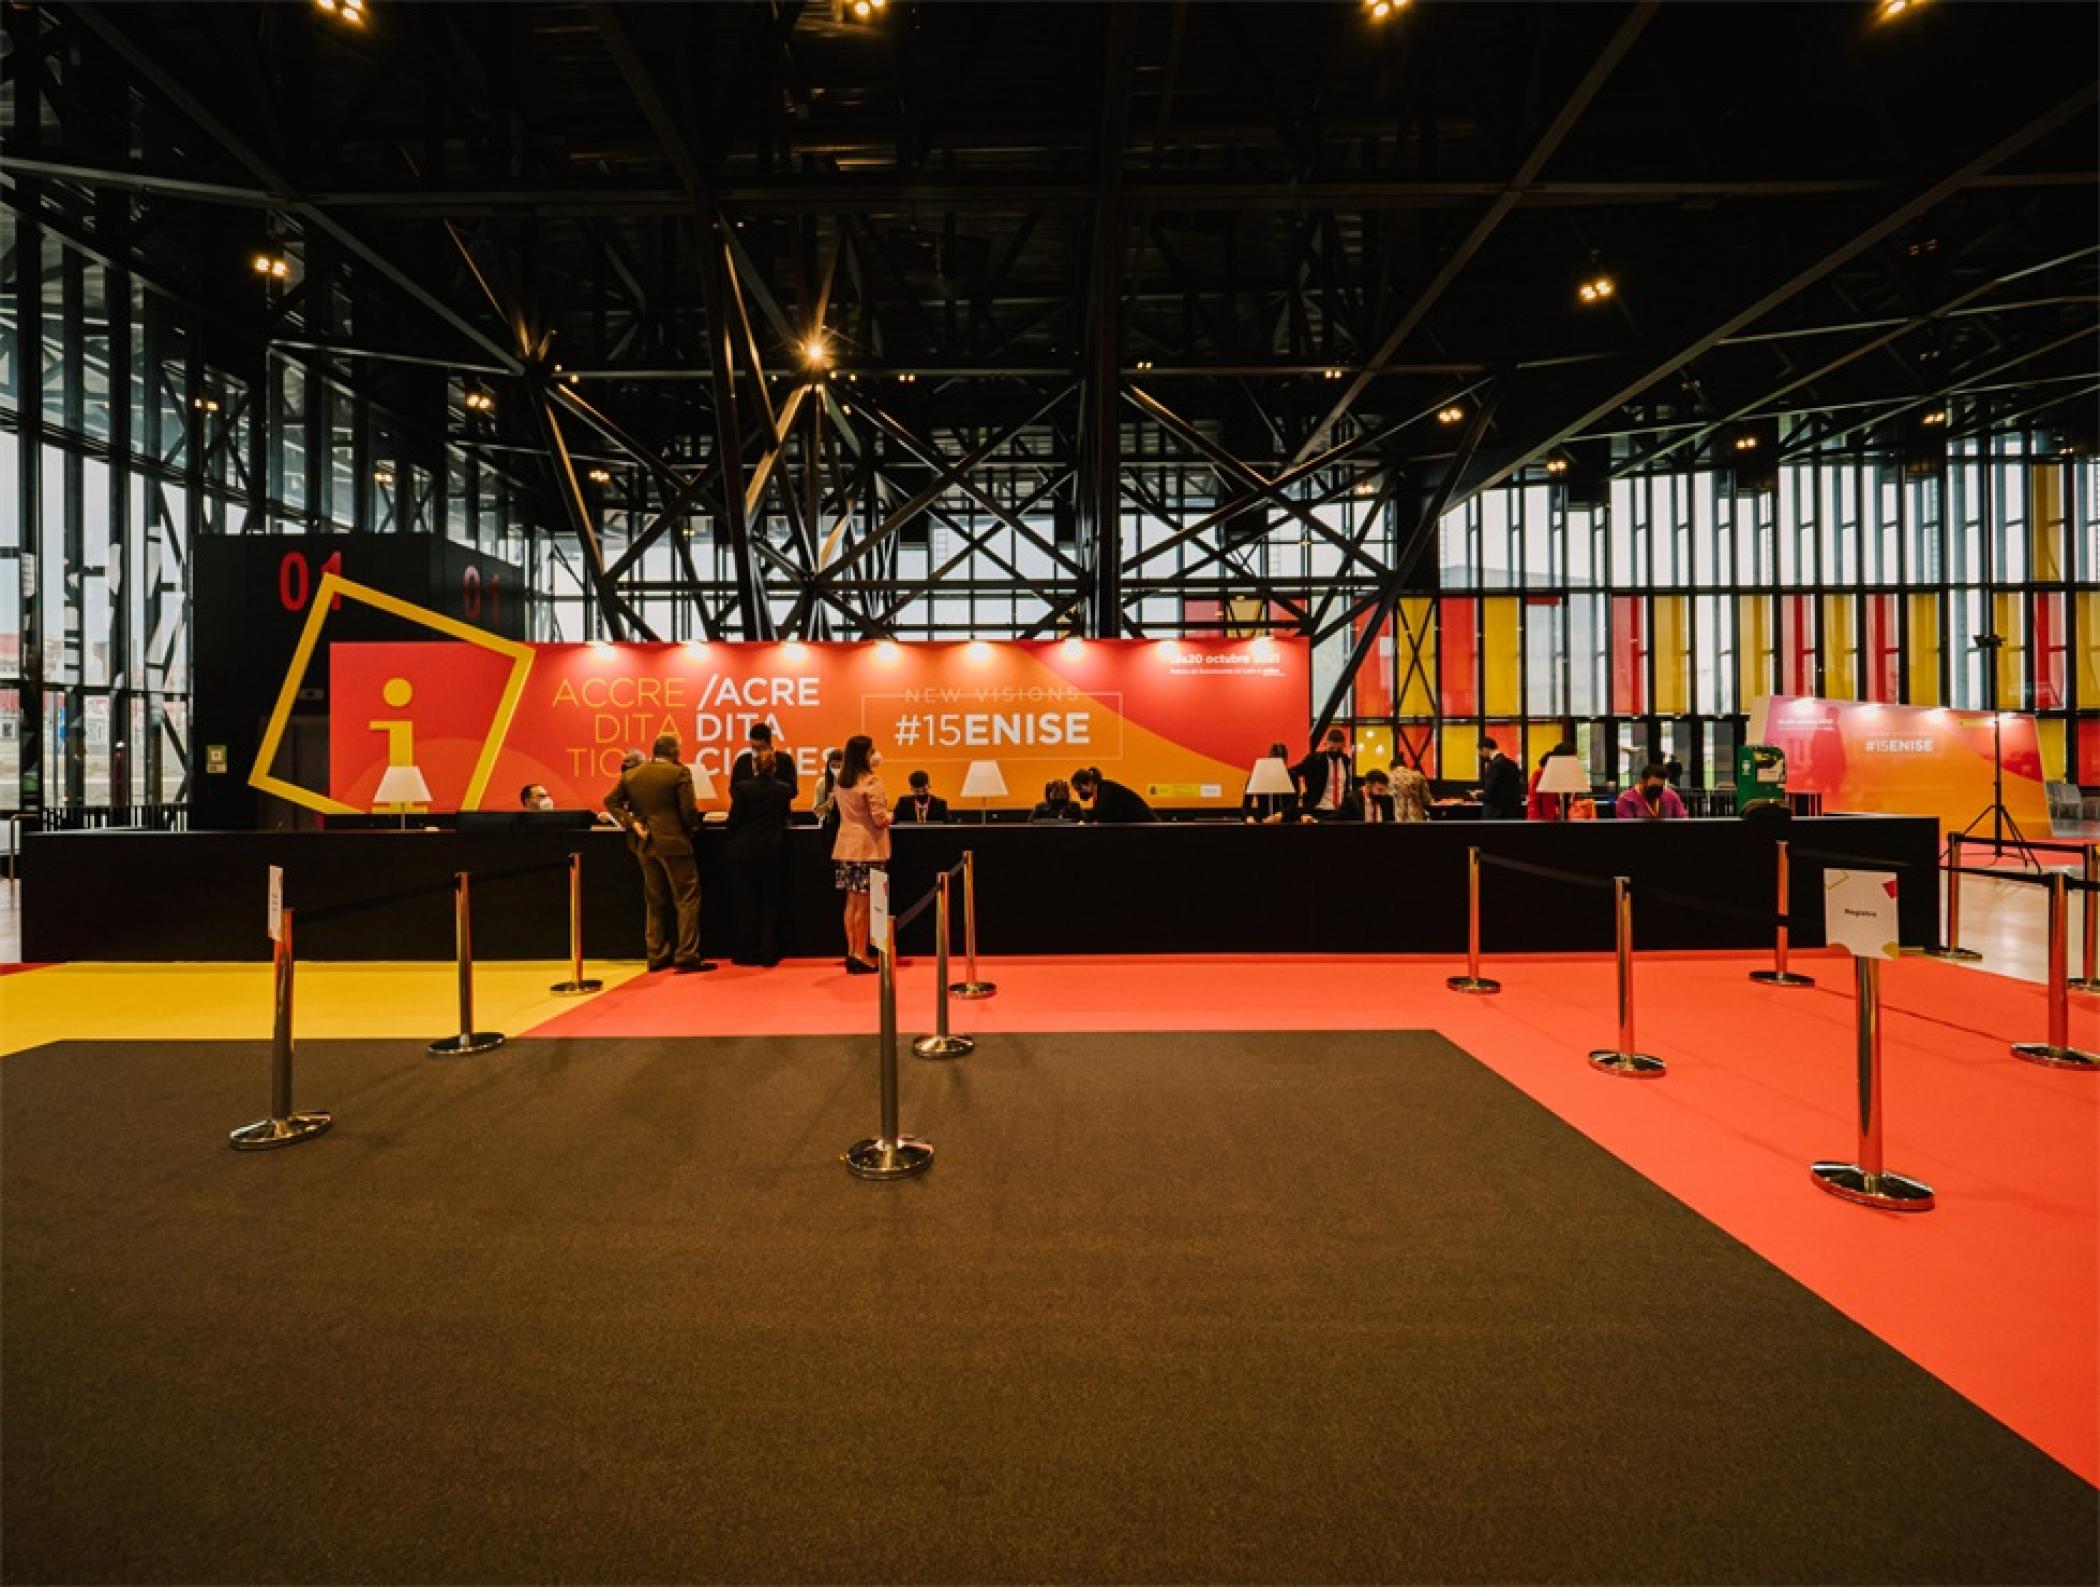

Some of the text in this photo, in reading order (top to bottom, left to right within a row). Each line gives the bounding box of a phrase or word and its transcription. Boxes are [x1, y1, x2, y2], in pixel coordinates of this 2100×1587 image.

[279, 551, 342, 612] 01
[553, 677, 687, 708] ACCRE
[697, 673, 820, 711] /ACRE
[906, 686, 1080, 704] NEW VISIONS
[595, 713, 682, 744] DITA
[696, 713, 785, 742] DITA
[895, 711, 1090, 746] #15ENISE
[1866, 739, 1934, 753] #15ENISE
